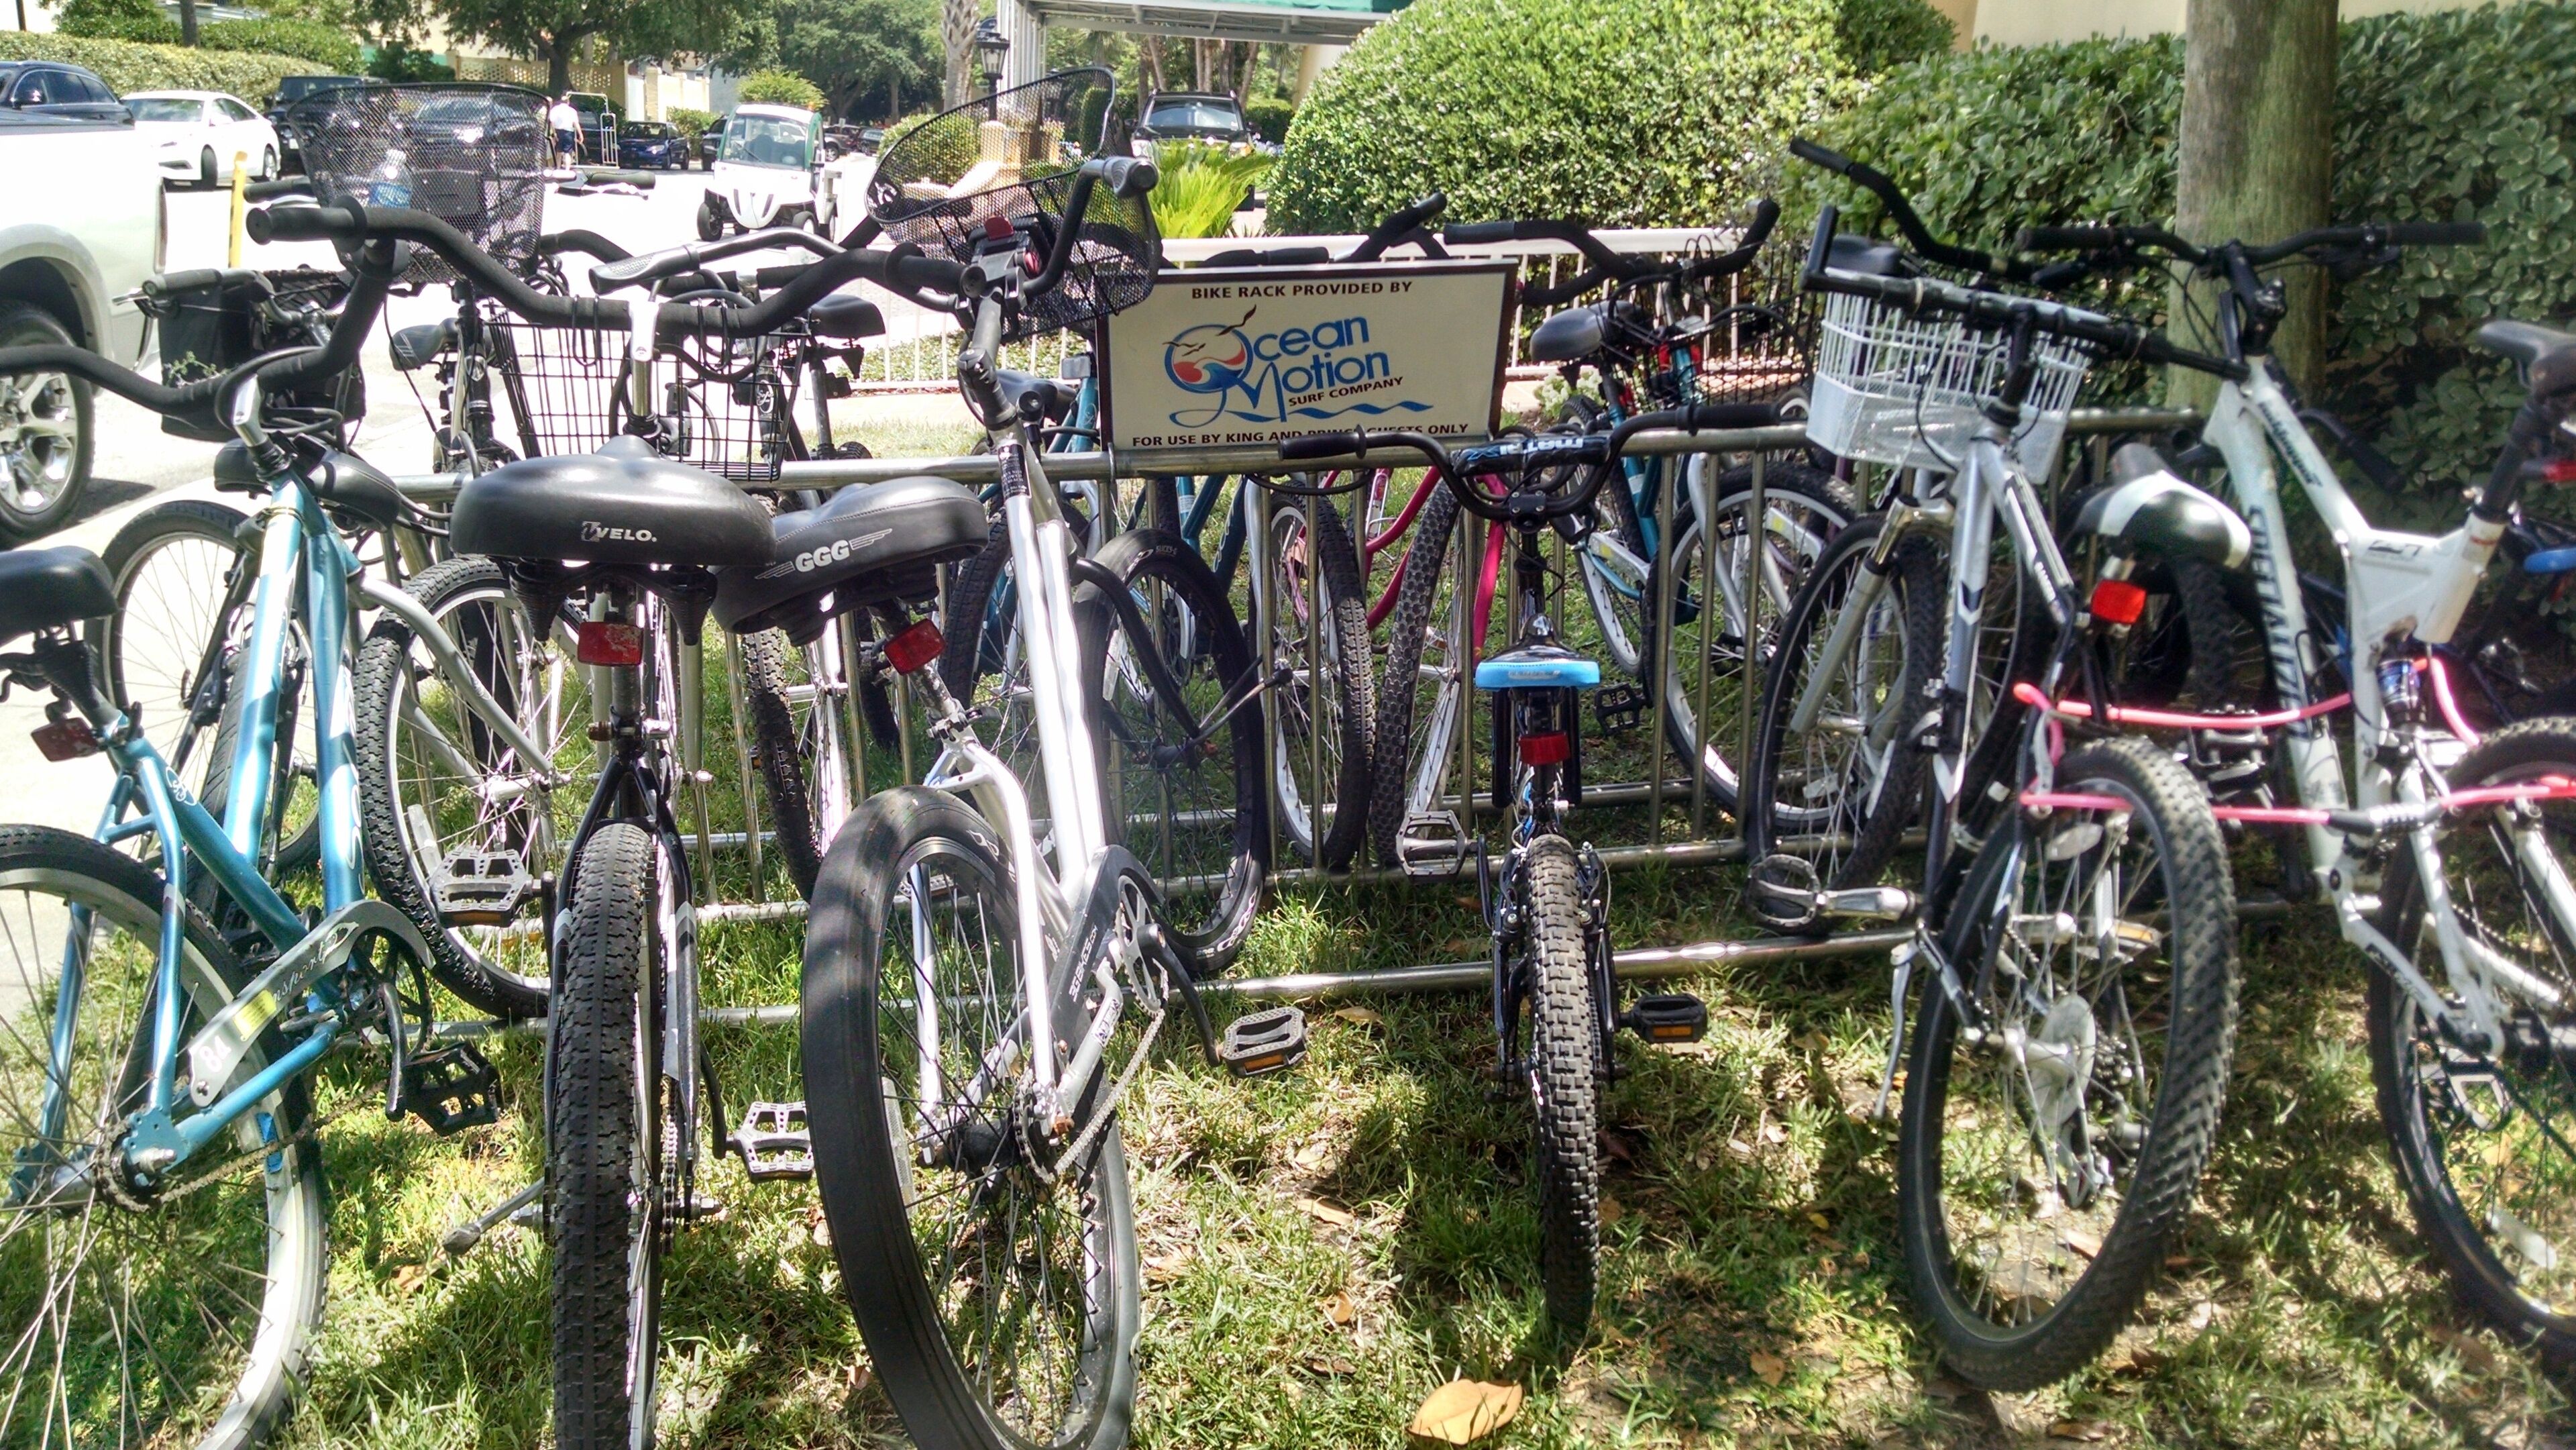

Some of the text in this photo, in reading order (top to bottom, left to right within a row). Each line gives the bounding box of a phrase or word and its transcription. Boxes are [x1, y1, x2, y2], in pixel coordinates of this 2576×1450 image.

[1191, 281, 1413, 299] BIKE RACK PROVIDED BY
[1165, 316, 1370, 395] Ocean
[1236, 352, 1391, 422] Motion
[1289, 376, 1403, 407] SURF COMPANY
[1132, 437, 1162, 447] FOR
[1168, 435, 1196, 446] USE
[1201, 433, 1220, 444] BY
[1226, 432, 1263, 443] KING
[1269, 430, 1303, 441] AND
[1428, 423, 1468, 435] ONLY
[795, 539, 850, 572] GGG
